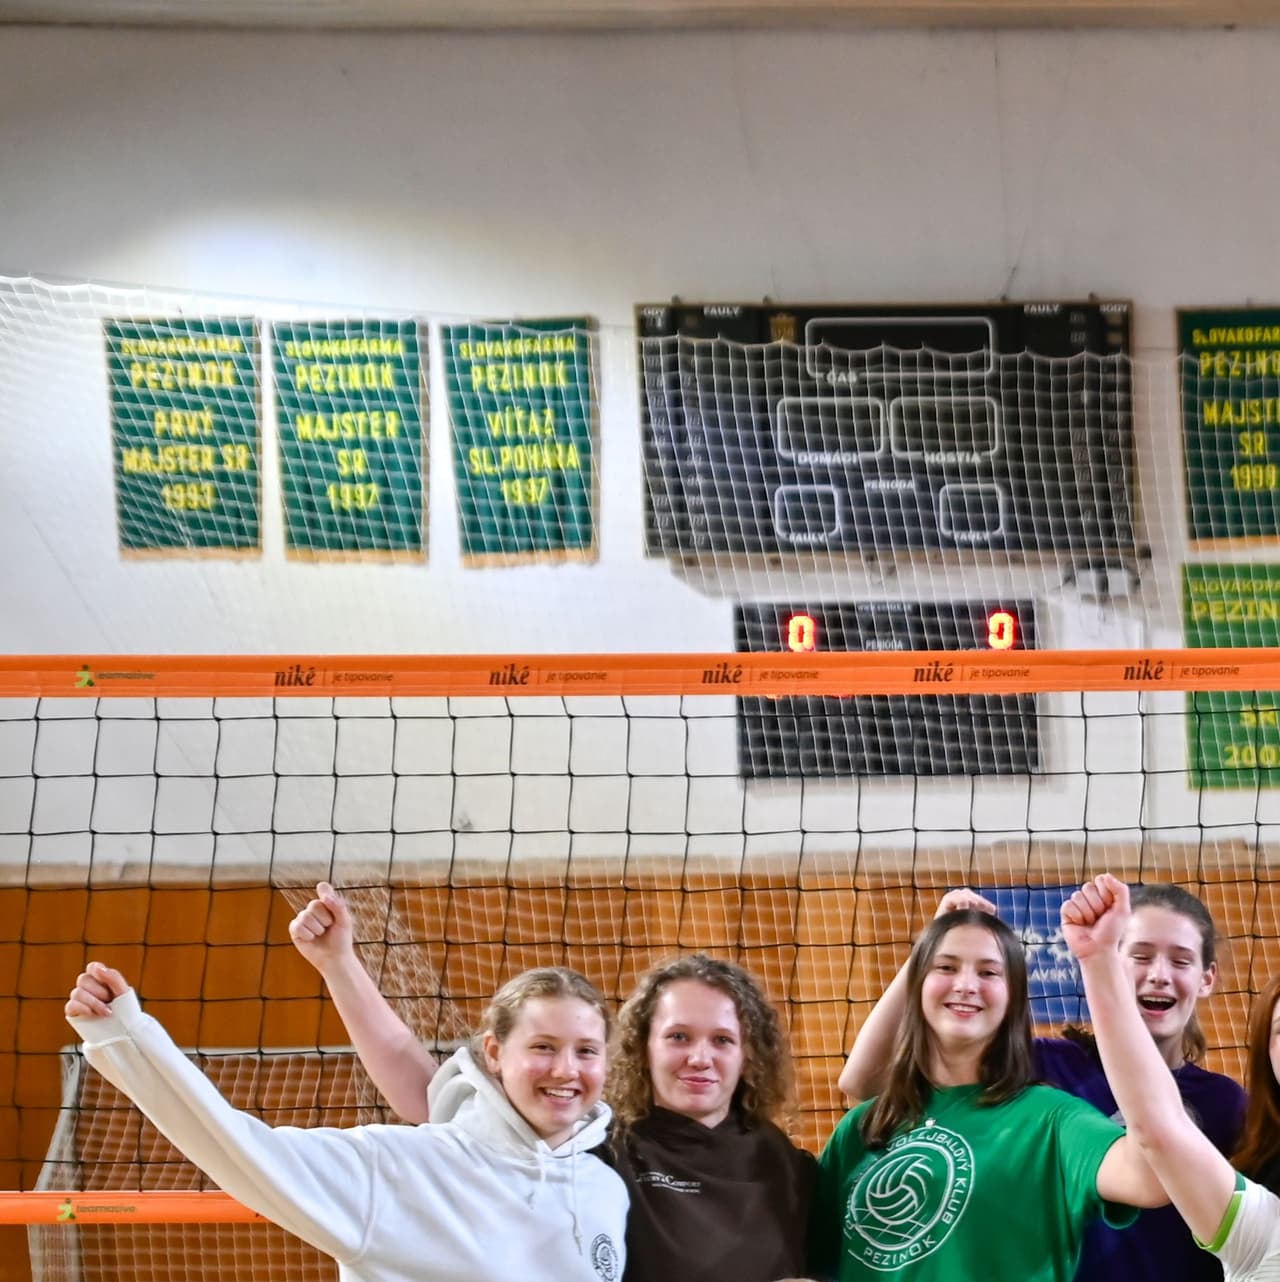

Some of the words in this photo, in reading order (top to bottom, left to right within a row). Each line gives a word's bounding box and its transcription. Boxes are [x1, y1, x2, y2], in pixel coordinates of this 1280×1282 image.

[131, 361, 235, 388] PEZINOK
[295, 363, 394, 392] PEZINOK
[471, 362, 567, 391] PEZINOK
[296, 411, 399, 440] MAJSTER
[1239, 431, 1267, 456] SR
[122, 446, 216, 473] MAJSTER
[222, 444, 249, 472] SR
[337, 449, 365, 476] SR
[787, 614, 815, 651] 0
[988, 611, 1015, 650] 0
[274, 664, 316, 687] niké
[489, 663, 530, 686] niké
[701, 662, 743, 684] niké
[913, 660, 954, 682] niké
[1123, 658, 1164, 681] niké
[1240, 705, 1277, 727] SR
[941, 1177, 967, 1225] KLUB
[863, 1234, 937, 1266] PEZINOK
